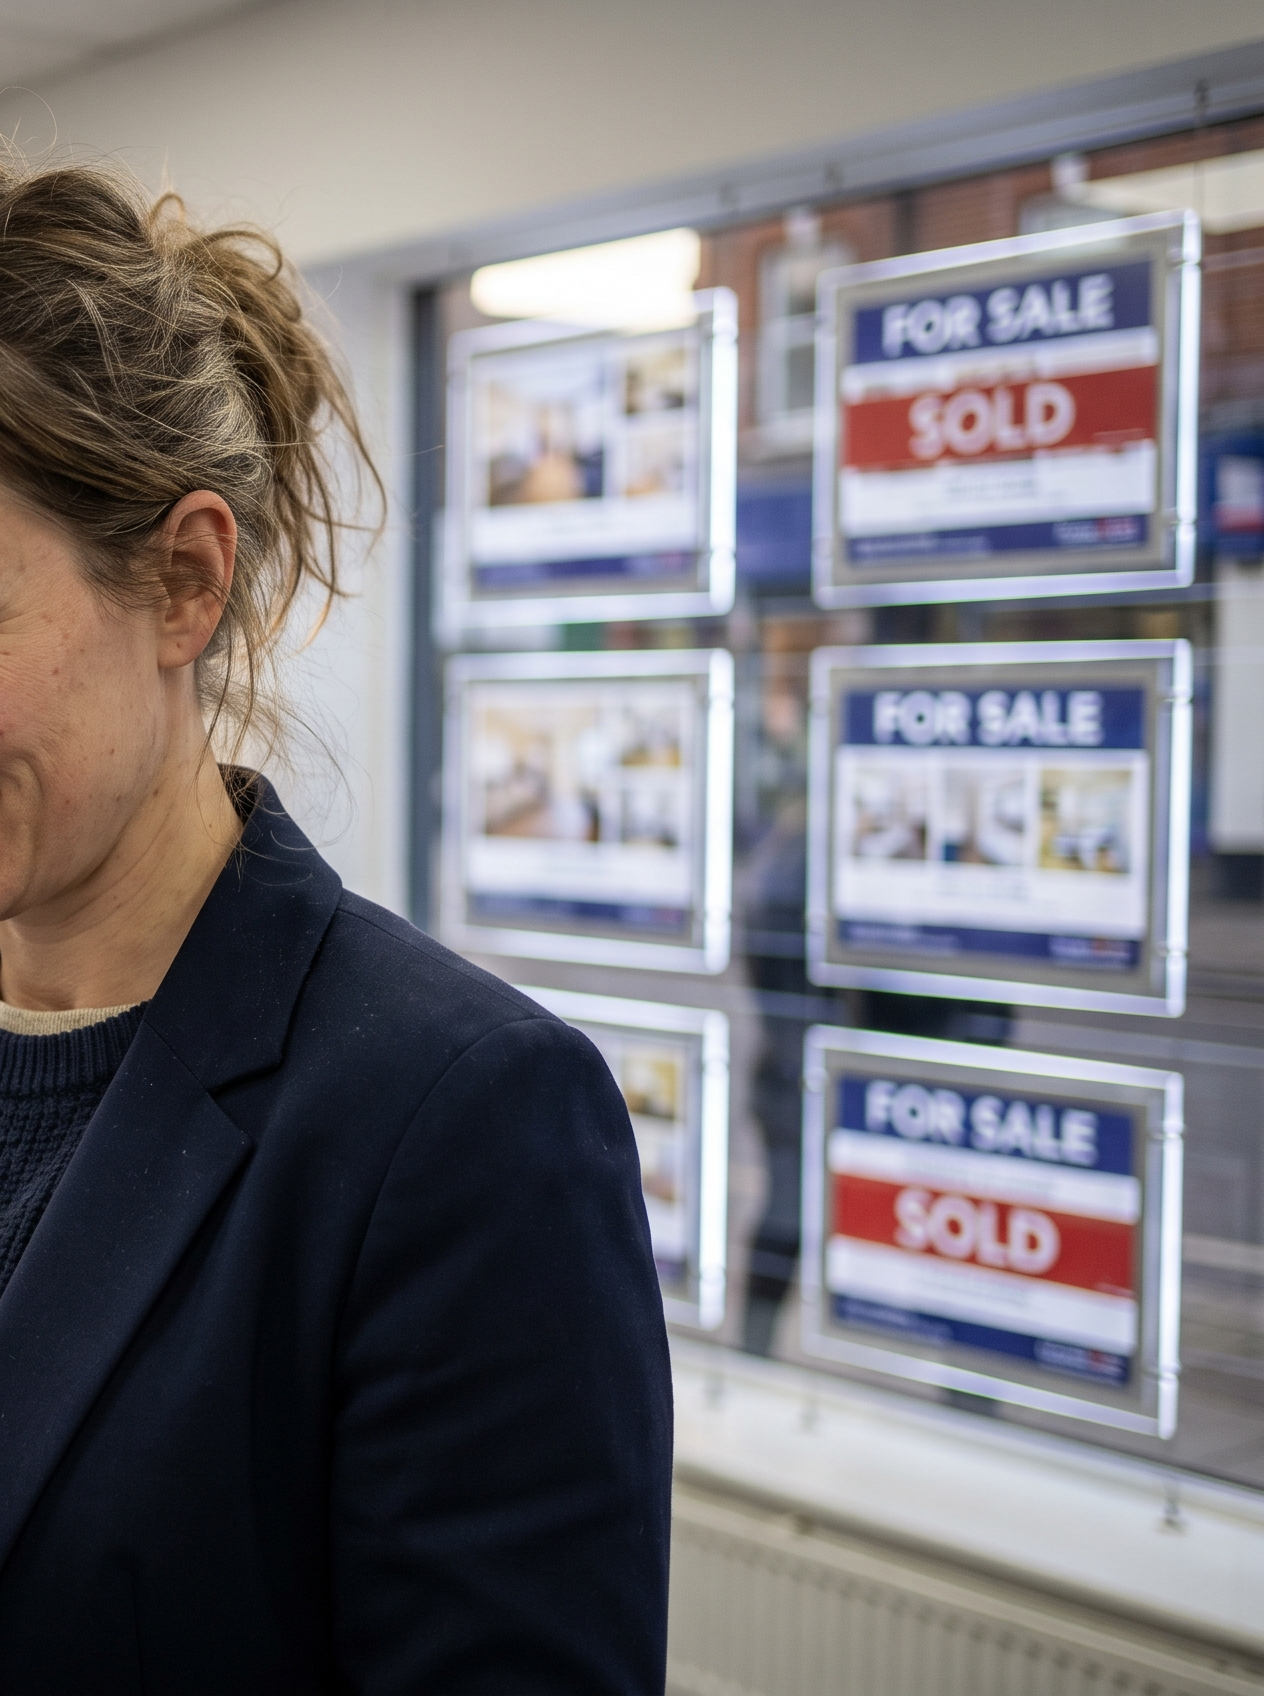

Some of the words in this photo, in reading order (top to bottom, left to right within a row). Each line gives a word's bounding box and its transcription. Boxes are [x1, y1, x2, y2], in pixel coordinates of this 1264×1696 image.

[882, 296, 981, 358] FOR
[987, 273, 1114, 344] SALE
[908, 381, 1077, 461] SOLD
[873, 690, 972, 745] FOR
[977, 690, 1104, 746] SALE
[865, 1080, 966, 1145] FOR
[970, 1095, 1098, 1166] SALE
[893, 1186, 1061, 1276] SOLD
